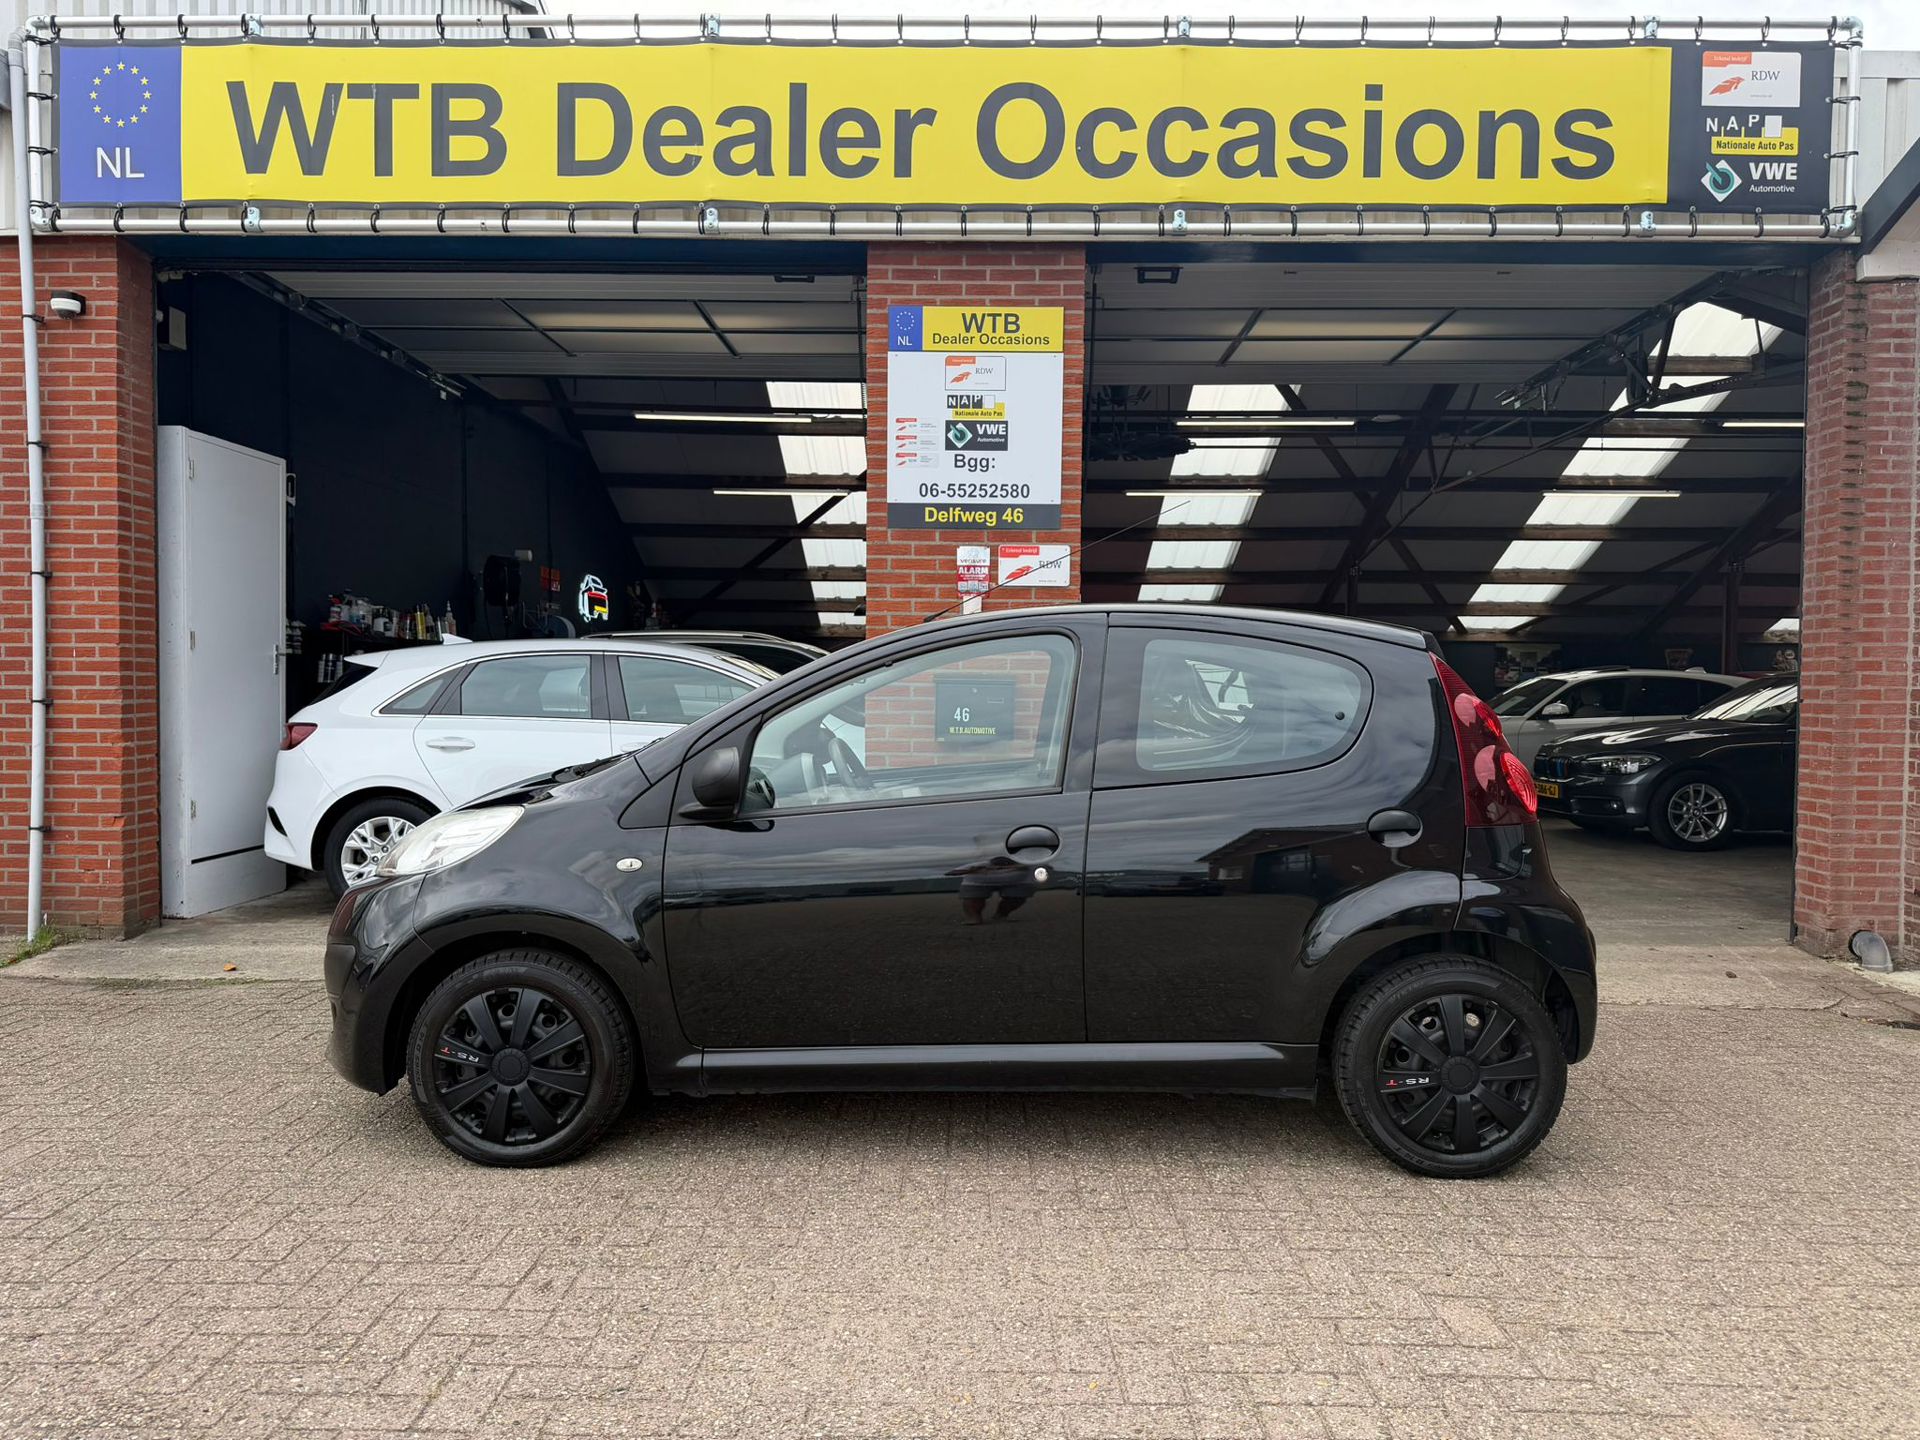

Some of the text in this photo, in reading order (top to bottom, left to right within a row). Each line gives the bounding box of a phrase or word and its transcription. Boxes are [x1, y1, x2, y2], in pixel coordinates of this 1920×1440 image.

[1751, 70, 1780, 81] RDW
[226, 80, 1616, 180] WTB Dealer Occasions
[1716, 140, 1794, 151] Nationale Auto Pas
[96, 147, 145, 178] NL
[1749, 162, 1798, 181] VWE
[1749, 184, 1795, 193] Automotive
[962, 313, 1021, 334] WTB
[897, 336, 913, 346] NL
[932, 333, 1050, 346] Dealer Occasions
[975, 367, 994, 375] RDW
[976, 424, 1007, 435] VWE
[953, 453, 996, 472] Bgg:
[919, 482, 1031, 499] 06-55252580
[924, 507, 1024, 526] Delfweg 46
[958, 566, 989, 575] ALARM
[953, 707, 970, 722] 46
